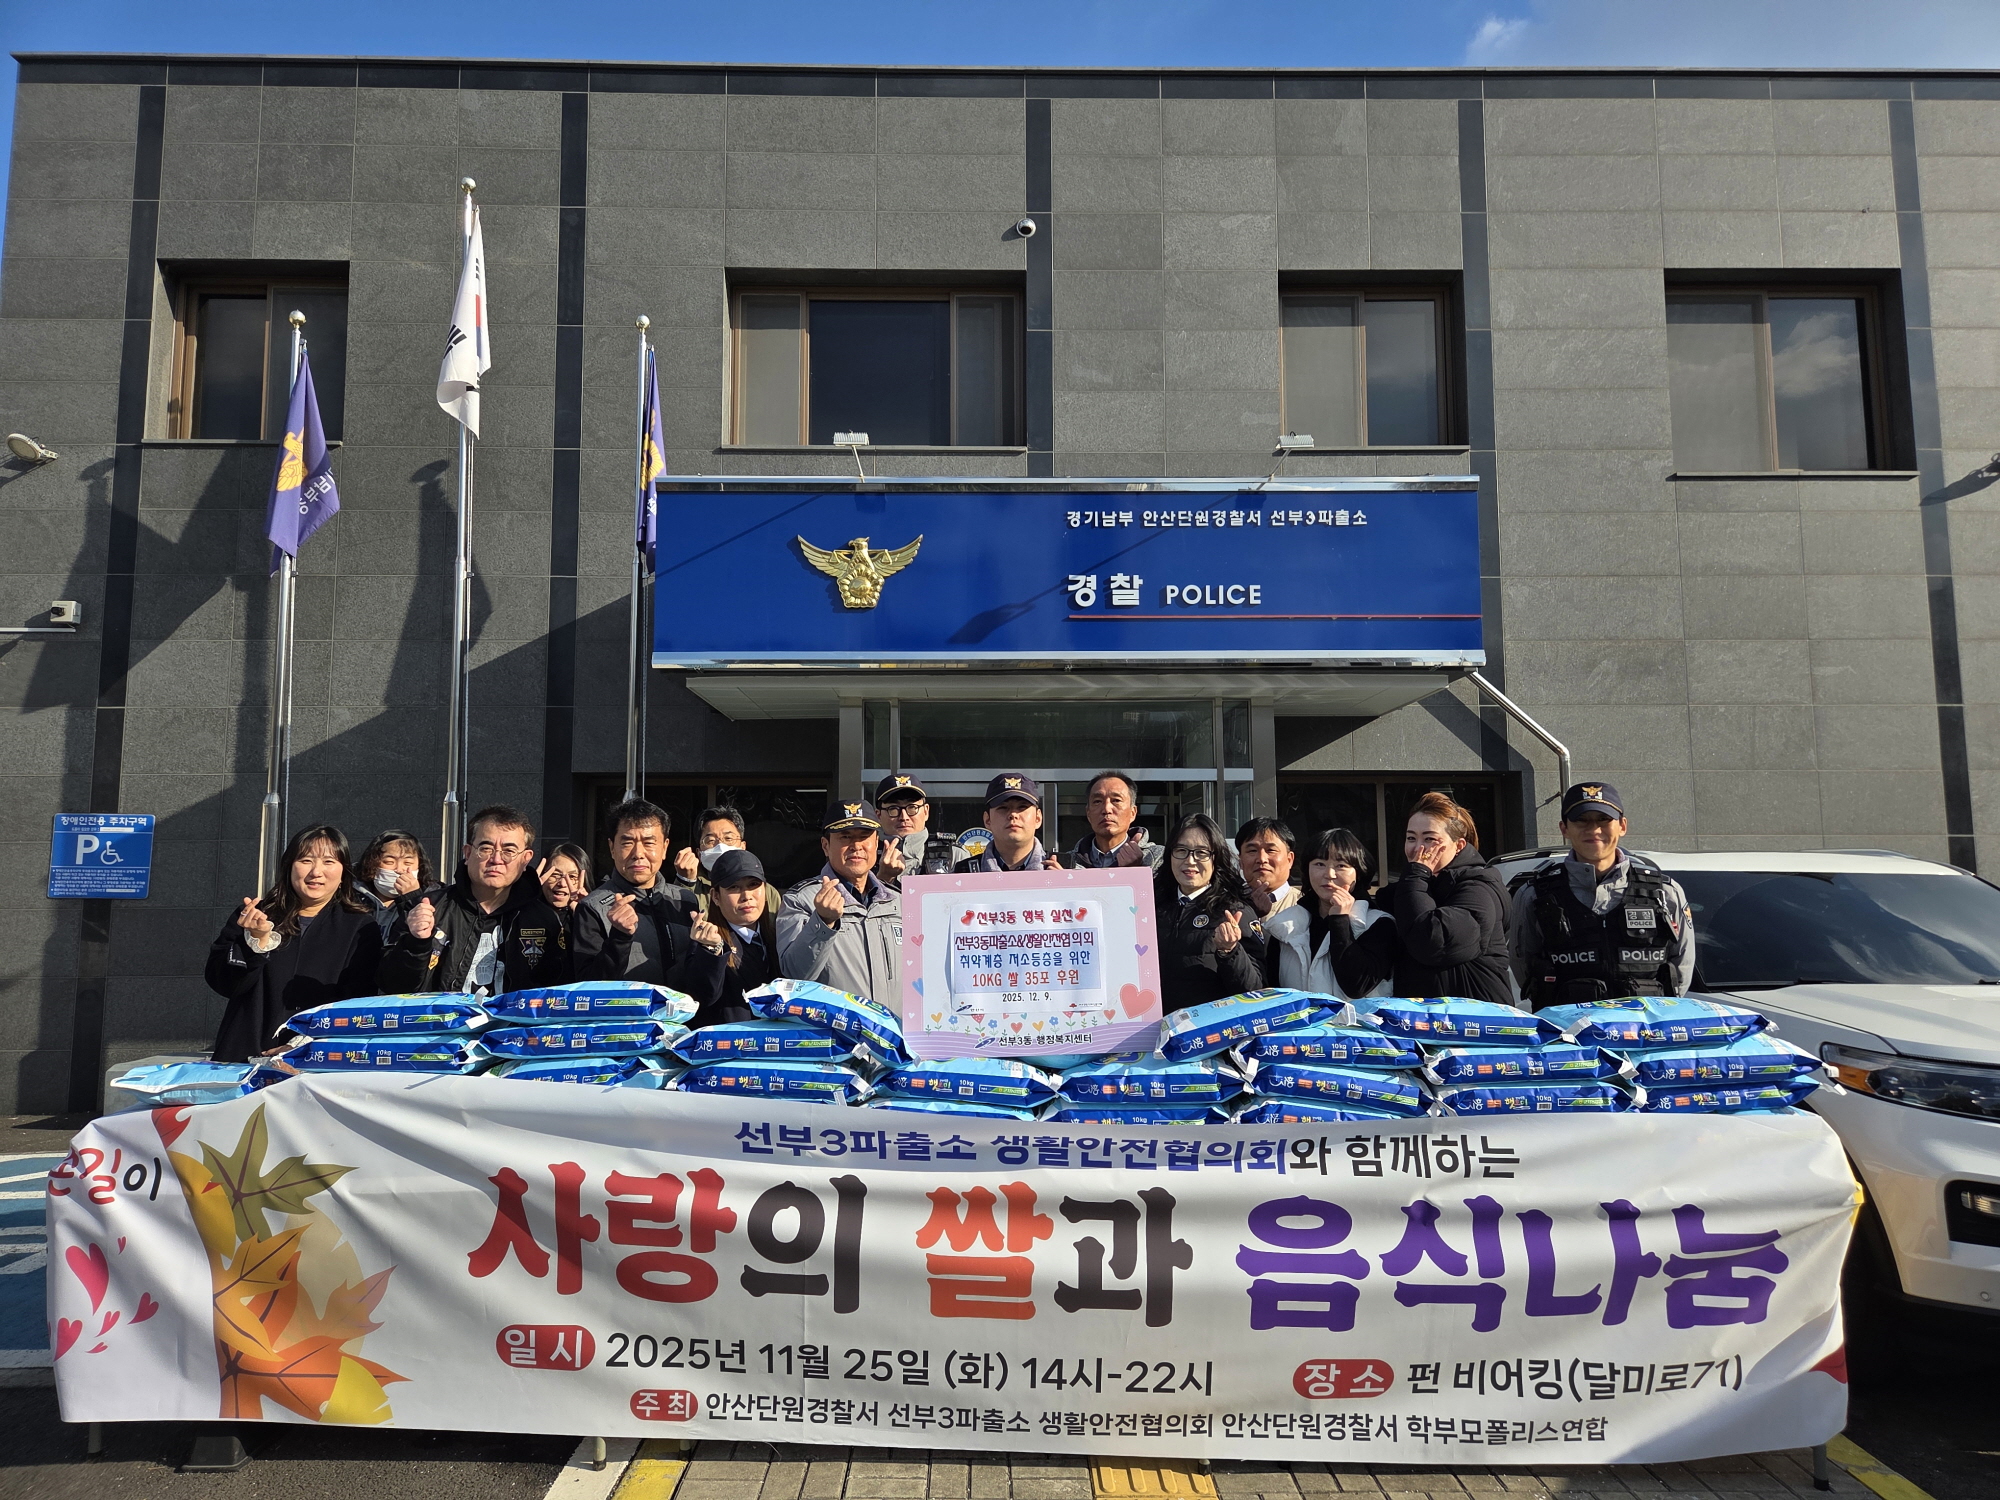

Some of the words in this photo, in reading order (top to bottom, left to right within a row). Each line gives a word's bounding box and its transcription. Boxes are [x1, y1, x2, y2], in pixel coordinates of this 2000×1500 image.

[1067, 510, 1133, 527] 경기남부
[1143, 510, 1262, 527] 안산단원경찰서
[1270, 509, 1368, 526] 선부3파출소
[1166, 584, 1262, 605] POLICE
[61, 816, 106, 826] 장애인전용
[109, 817, 147, 826] 주차구역
[75, 834, 100, 865] P
[977, 910, 1017, 925] 선부3동
[1022, 909, 1045, 924] 행복
[1051, 909, 1074, 923] 실천
[955, 931, 1094, 950] 선부3동파출소&생활안전협의회
[960, 953, 1003, 968] 취약계층
[1069, 950, 1091, 965] 위한
[1551, 951, 1596, 964] POLICE
[1621, 949, 1665, 961] POLICE
[972, 973, 1002, 987] 10KG
[1008, 972, 1018, 987] 쌀
[1025, 971, 1050, 985] 35포
[1057, 969, 1080, 985] 후원
[1002, 993, 1025, 1002] 2025.
[1029, 992, 1040, 1001] 12.
[1044, 992, 1052, 1001] 9.
[835, 1012, 849, 1023] 10kg
[999, 1036, 1032, 1046] 선부3동
[1036, 1034, 1092, 1045] 행정복지센터
[1347, 1083, 1363, 1091] 10kg
[734, 1121, 977, 1161] 선부3파출소
[991, 1134, 1331, 1175] 생활안전협의회와
[1345, 1135, 1520, 1178] 함께하는
[467, 1161, 868, 1314] 사랑의
[915, 1181, 1194, 1327] 쌀과
[1235, 1195, 1790, 1332] 음식나눔
[606, 1333, 747, 1374] 2025년
[759, 1344, 830, 1380] 11월
[843, 1349, 930, 1386] 25일
[943, 1349, 1009, 1390] (화)
[1021, 1356, 1213, 1397] 14시-22시
[1407, 1363, 1440, 1395] 펀
[1453, 1354, 1742, 1402] 비어킹(달미로71)
[706, 1393, 879, 1426] 안산단원경찰서
[888, 1403, 1031, 1434] 선부3파출소
[1039, 1411, 1213, 1438] 생활안전협의회
[1222, 1413, 1399, 1442] 안산단원경찰서
[1406, 1416, 1608, 1446] 학부모폴리스연합
